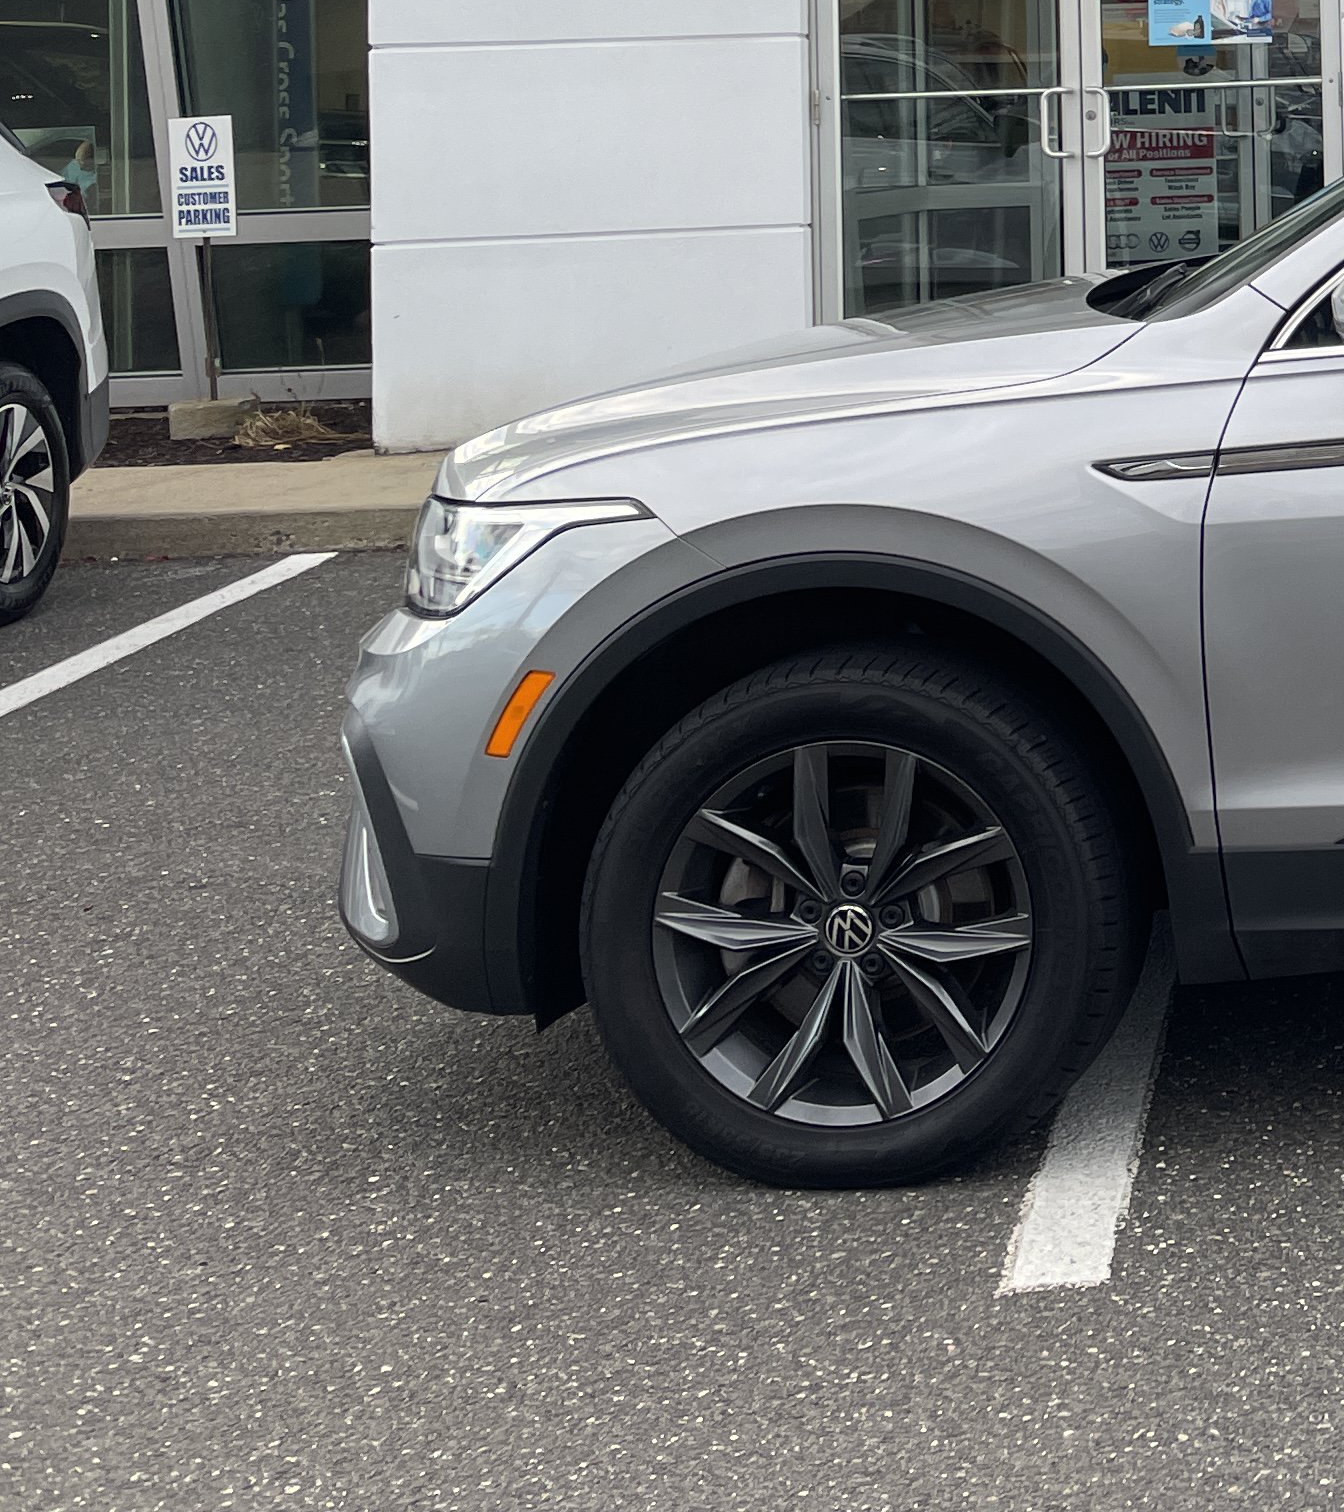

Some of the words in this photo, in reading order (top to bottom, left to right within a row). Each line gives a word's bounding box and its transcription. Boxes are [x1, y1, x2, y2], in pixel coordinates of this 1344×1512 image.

[1136, 132, 1208, 149] HIRING
[1121, 150, 1137, 160] All
[1140, 148, 1191, 158] Positions
[178, 164, 225, 183] SALES
[177, 191, 229, 207] CUSTOMER
[178, 207, 231, 226] PARKING
